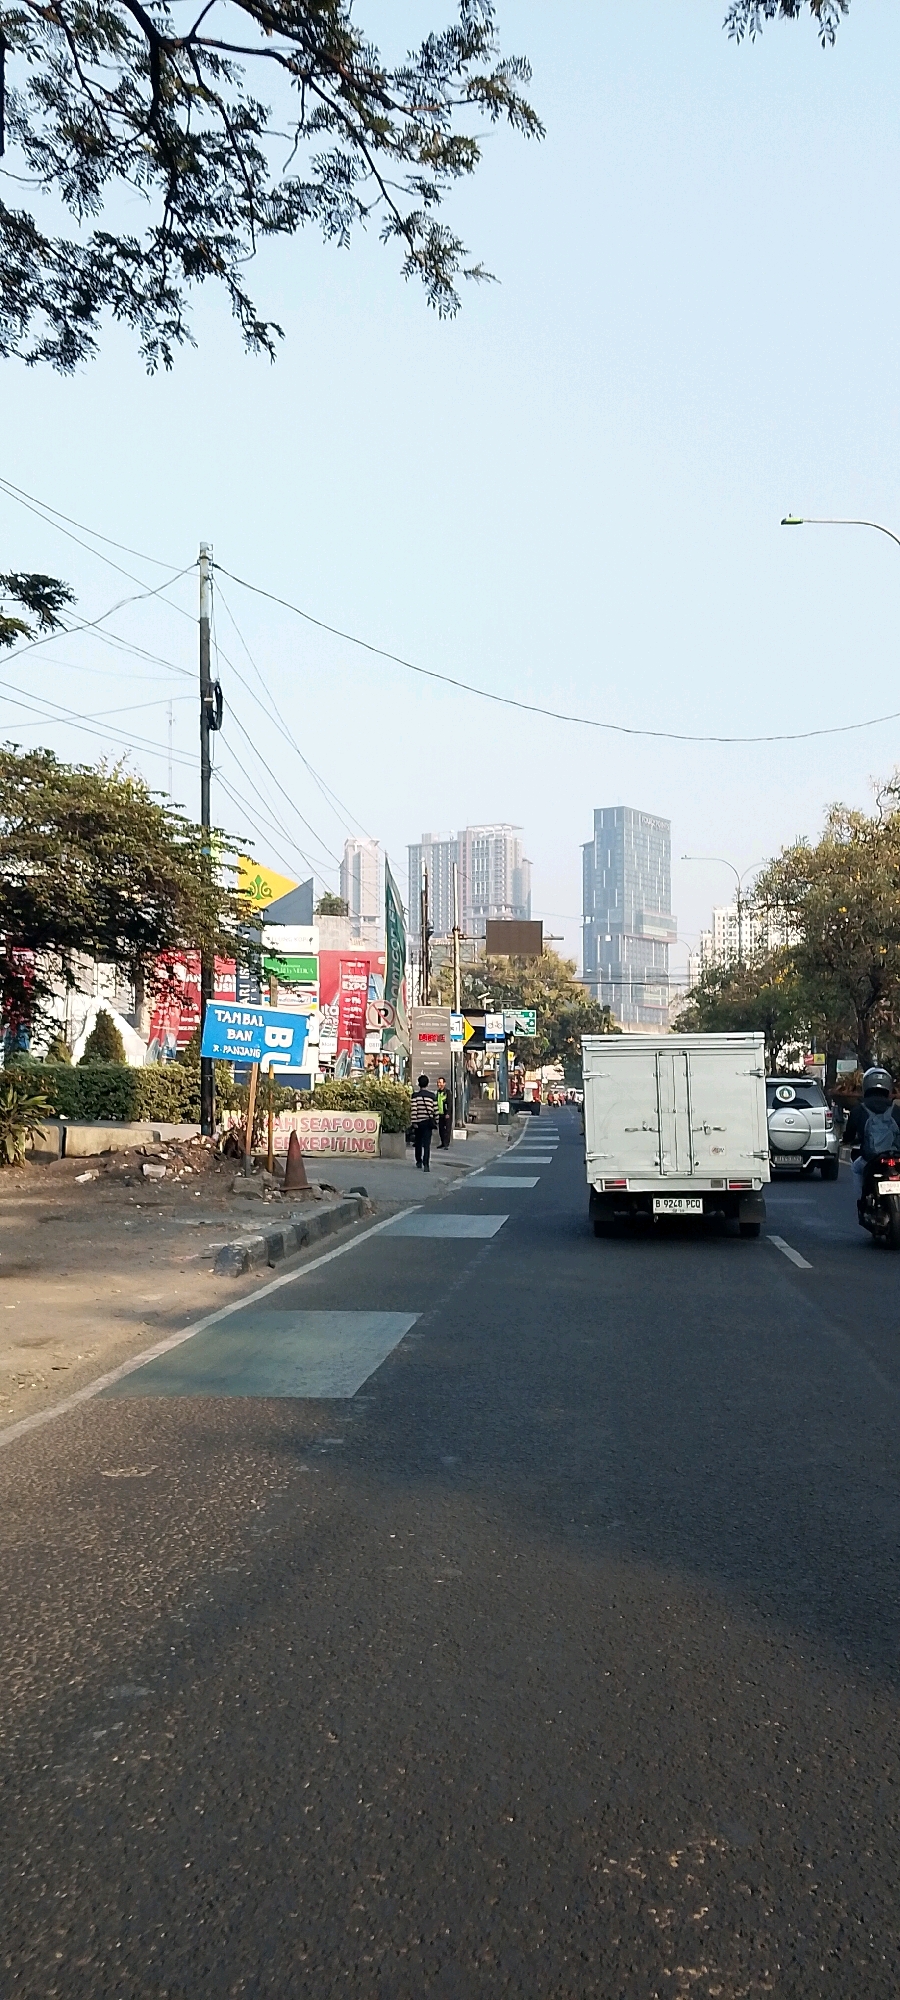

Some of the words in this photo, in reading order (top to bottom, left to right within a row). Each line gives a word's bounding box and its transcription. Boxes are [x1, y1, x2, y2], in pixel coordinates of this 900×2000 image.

[342, 981, 368, 991] EXPO
[214, 1009, 265, 1027] TAMBAL
[227, 1029, 254, 1042] BAN
[223, 1045, 261, 1058] PANJANG
[300, 1117, 377, 1132] SEAFOOD
[299, 1136, 376, 1152] KEPITING
[655, 1199, 661, 1208] B
[685, 1199, 701, 1209] PCQ
